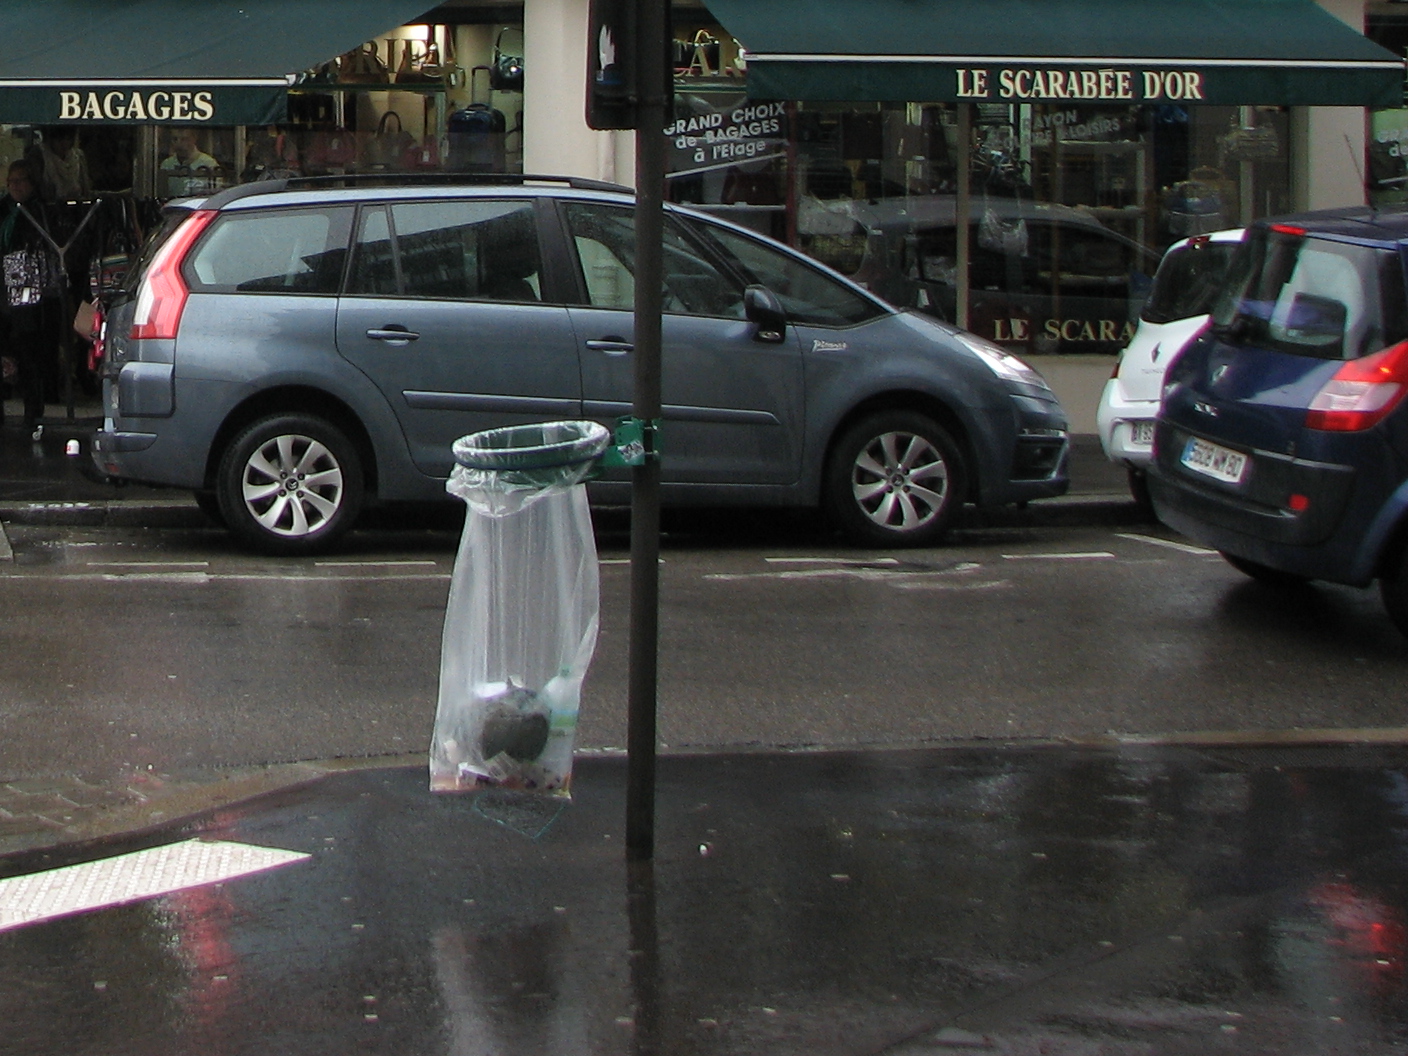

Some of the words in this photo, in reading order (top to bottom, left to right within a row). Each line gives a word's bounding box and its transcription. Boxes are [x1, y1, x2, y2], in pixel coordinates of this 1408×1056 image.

[956, 69, 990, 97] LE
[1142, 71, 1203, 100] D'OR
[59, 91, 214, 120] BAGAGES
[731, 101, 786, 123] CHOIX
[675, 135, 698, 149] de
[705, 118, 780, 144] BAGAGES
[994, 318, 1029, 341] LE
